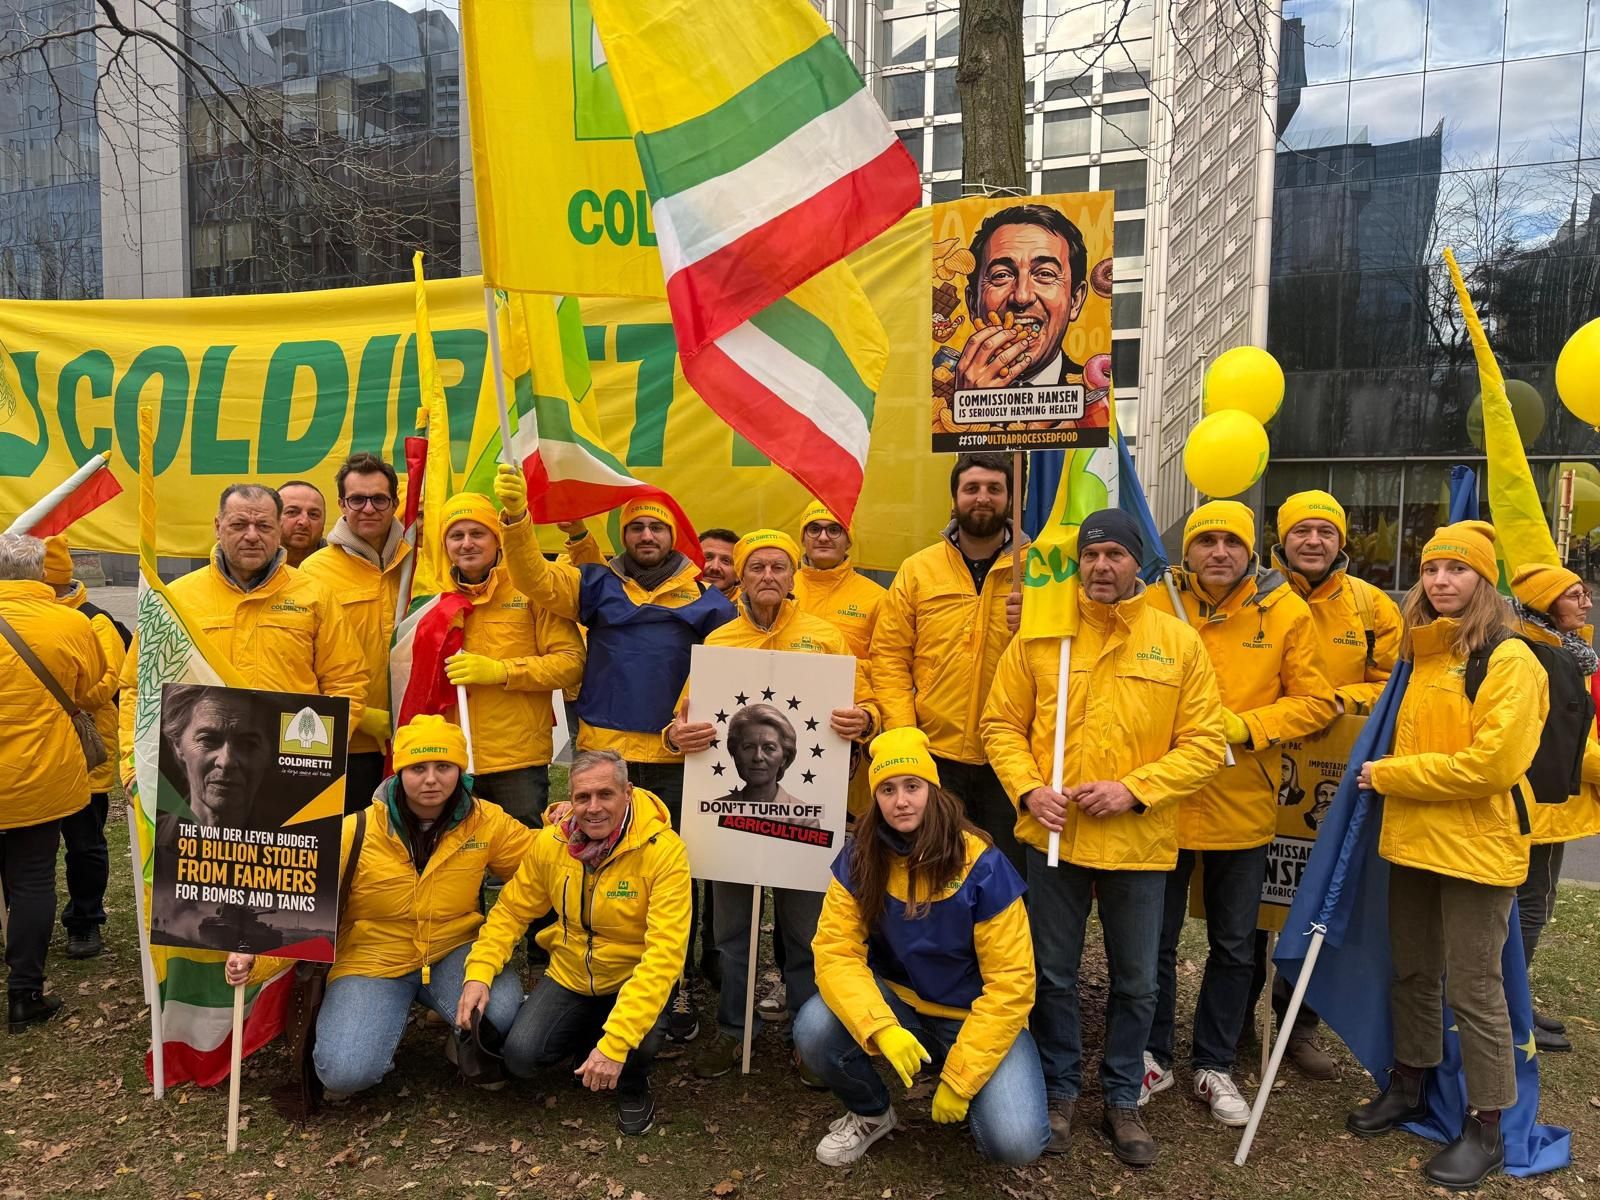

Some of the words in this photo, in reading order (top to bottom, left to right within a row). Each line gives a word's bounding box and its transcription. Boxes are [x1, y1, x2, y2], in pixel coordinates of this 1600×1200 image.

[959, 392, 1034, 407] COMMISSIONER
[1038, 390, 1078, 404] HANSEN
[959, 408, 966, 418] IS
[969, 406, 1008, 418] SERIOUSLY
[1010, 405, 1047, 416] HARMING
[1049, 404, 1078, 414] HEALTH
[1242, 641, 1273, 649] COLDIRETTI
[1333, 637, 1366, 648] COLDIRETTI
[1136, 652, 1175, 664] COLDIRETTI
[410, 746, 448, 755] COLDIRETTI
[1289, 741, 1302, 750] PAC
[278, 756, 332, 769] COLDIRETTI
[873, 757, 919, 774] COLDIRETTI
[700, 801, 746, 815] DON'T
[749, 803, 790, 816] TURN
[793, 805, 822, 817] OFF
[179, 823, 197, 838] THE
[200, 825, 220, 840] VON
[223, 827, 242, 842] DER
[245, 830, 274, 846] LEYEN
[277, 833, 319, 849] BUDGET:
[723, 815, 829, 845] AGRICULTURE
[178, 837, 197, 858] 90
[202, 839, 258, 864] BILLION
[262, 845, 318, 869] STOLEN
[177, 858, 228, 885] FROM
[233, 863, 317, 894] FARMERS
[175, 883, 198, 900] FOR
[202, 886, 245, 905] BOMBS
[248, 890, 273, 908] AND
[277, 893, 315, 912] TANKS
